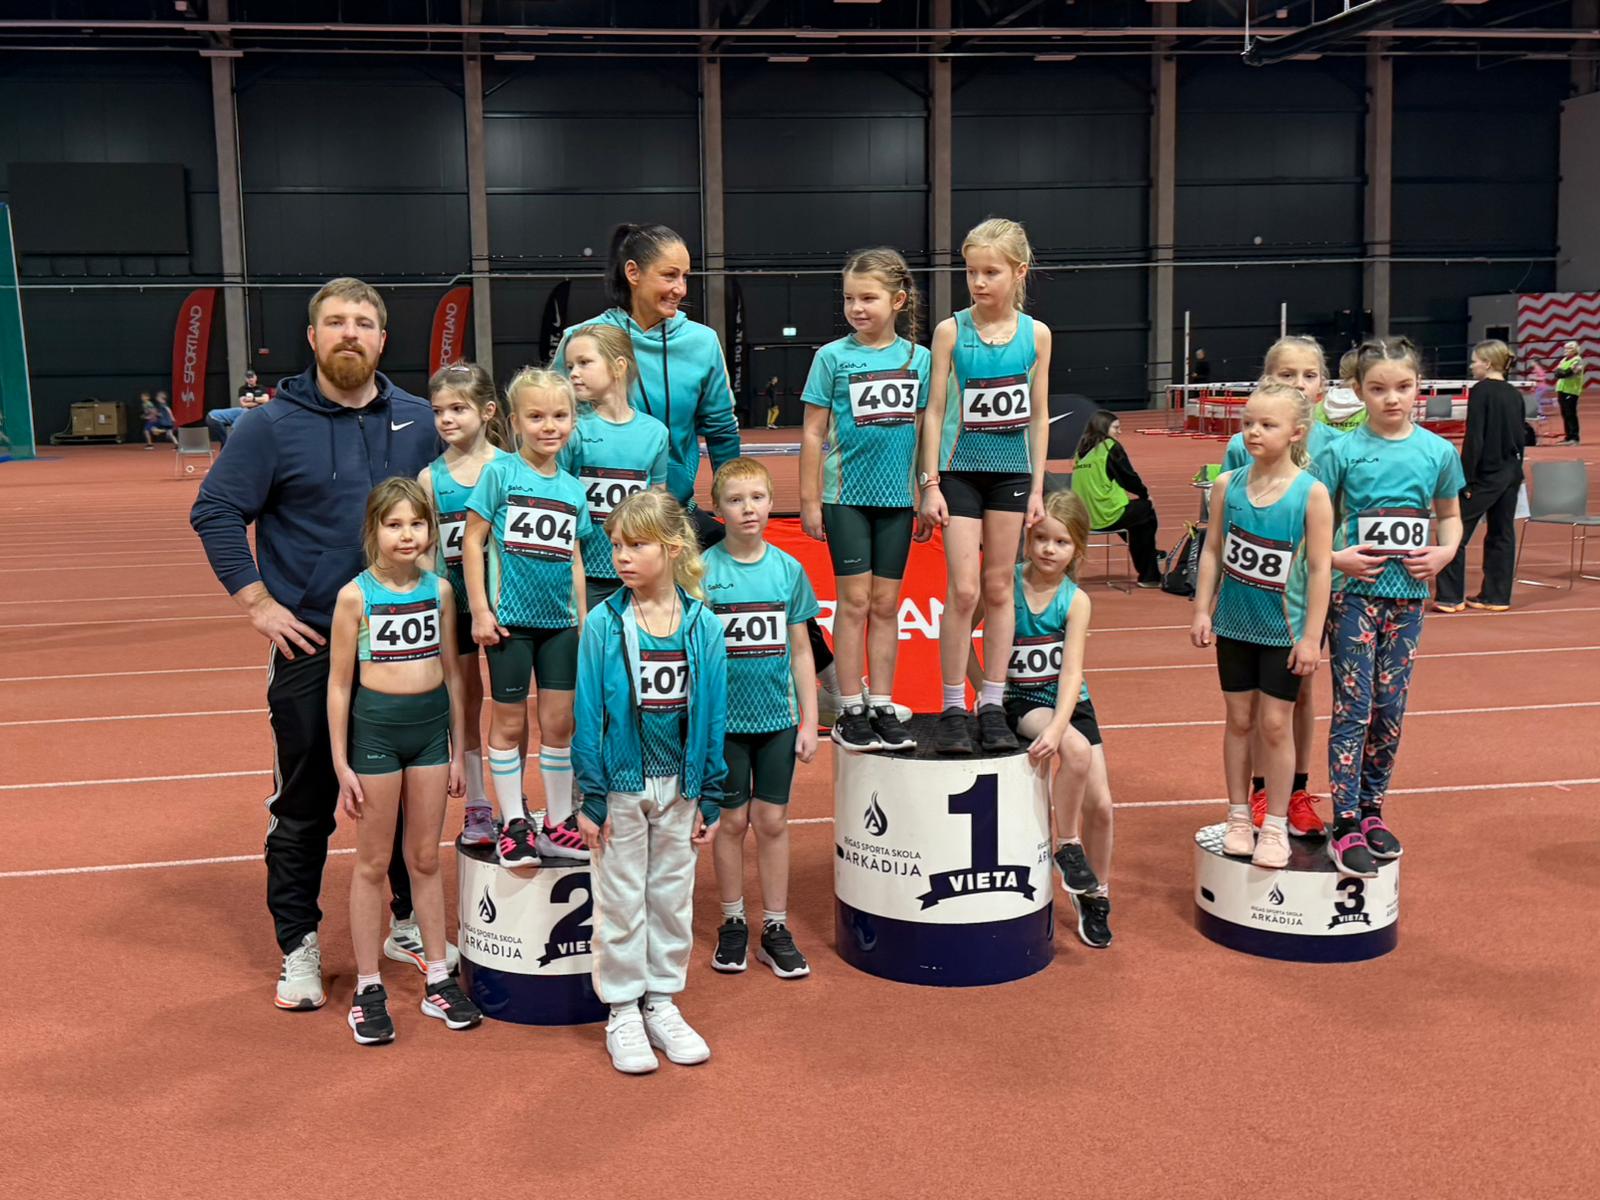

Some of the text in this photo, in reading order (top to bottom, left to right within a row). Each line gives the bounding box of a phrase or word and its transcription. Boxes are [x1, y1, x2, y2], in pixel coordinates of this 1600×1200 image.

[183, 305, 202, 384] SPORTLAND
[857, 383, 915, 410] 403
[969, 389, 1027, 418] 402
[509, 511, 572, 545] 404
[1364, 521, 1424, 546] 408
[1227, 539, 1282, 577] 398
[376, 614, 436, 646] 405
[724, 616, 778, 641] 401
[1008, 646, 1063, 673] 400
[948, 773, 998, 868] 1
[845, 850, 922, 877] ARKĀDIJA
[861, 842, 890, 856] SPORTA
[891, 848, 922, 859] SKOLA
[948, 871, 1018, 892] VIETA
[1334, 877, 1365, 913] 3
[550, 872, 593, 941] 2
[1338, 914, 1364, 922] VIETA
[465, 933, 522, 960] ARKĀDIJA
[499, 934, 522, 944] SKOLA
